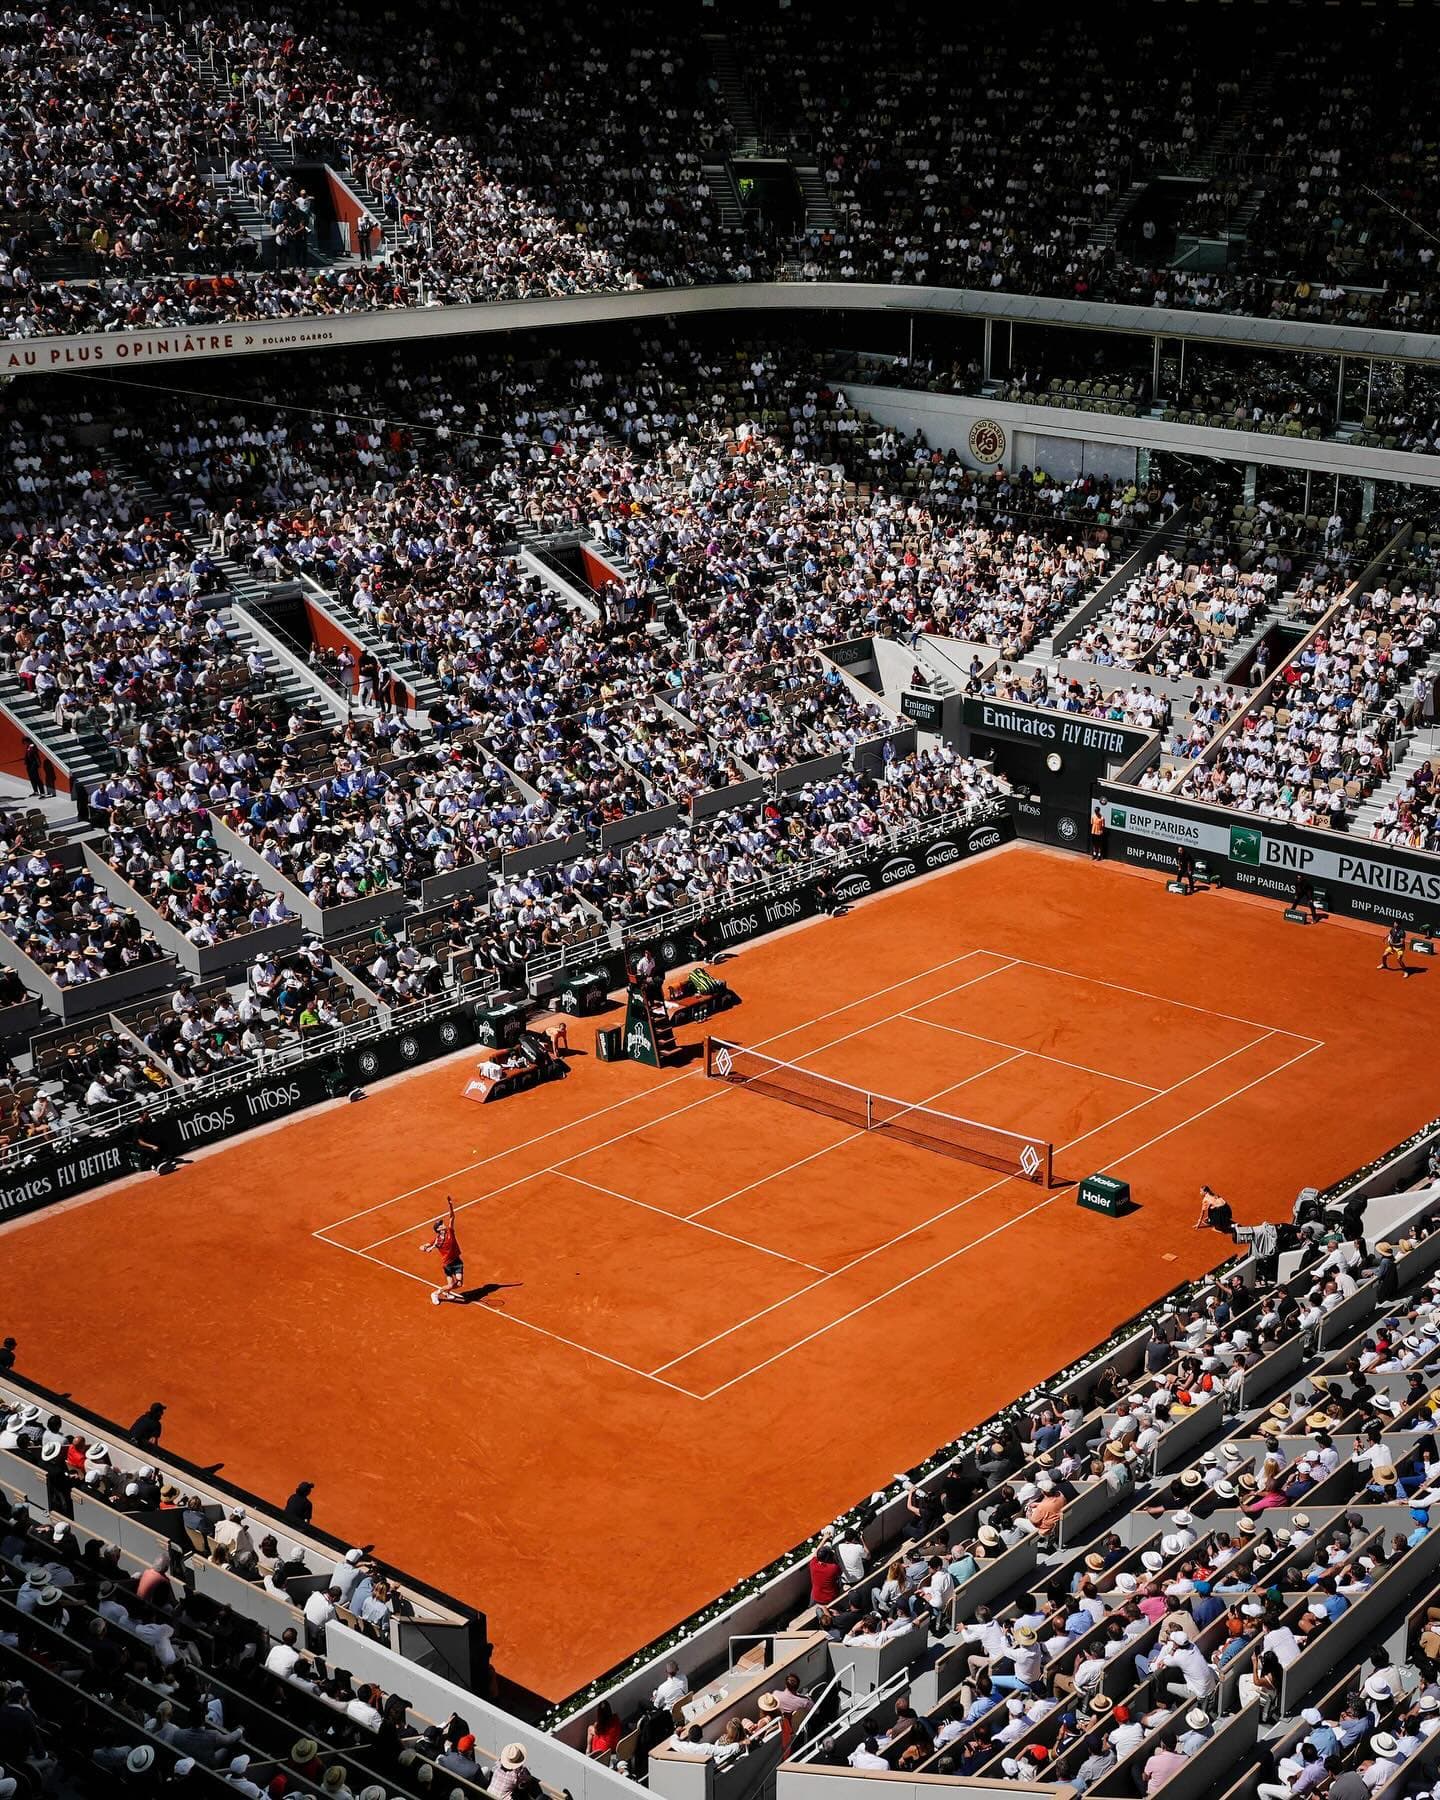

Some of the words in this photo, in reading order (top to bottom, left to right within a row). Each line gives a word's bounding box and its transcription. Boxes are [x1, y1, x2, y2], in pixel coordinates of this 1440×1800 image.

[8, 351, 36, 367] AU
[51, 346, 103, 363] PLUS
[116, 334, 234, 357] OPINIÂTRE
[262, 336, 297, 345] ROLAND
[300, 332, 333, 342] GARROS
[904, 698, 936, 713] Emirates
[983, 706, 1056, 739] Emirates
[1062, 723, 1081, 744] FLY
[1083, 727, 1124, 753] BETTER
[1018, 802, 1041, 816] Infosys
[1129, 813, 1152, 827] BNP
[1154, 819, 1199, 839] PARIBAS
[1126, 846, 1145, 857] BNP
[1146, 851, 1179, 866] PARIBA
[1266, 841, 1314, 869] BNP
[1338, 857, 1440, 900] PARIBAS
[1236, 872, 1256, 884] BNP
[1257, 877, 1296, 894] PARIBAS
[764, 898, 801, 922] Infosys
[1351, 899, 1372, 911] BNP
[1373, 904, 1415, 922] PARIBAS
[719, 914, 758, 939] Infosys
[246, 1082, 301, 1115] Infosys
[177, 1106, 235, 1140] Infosys
[0, 1177, 52, 1209] irates
[57, 1163, 76, 1187] FLY
[79, 1147, 121, 1179] BETTER
[1089, 1176, 1120, 1189] Haier
[1082, 1189, 1111, 1208] Haier
